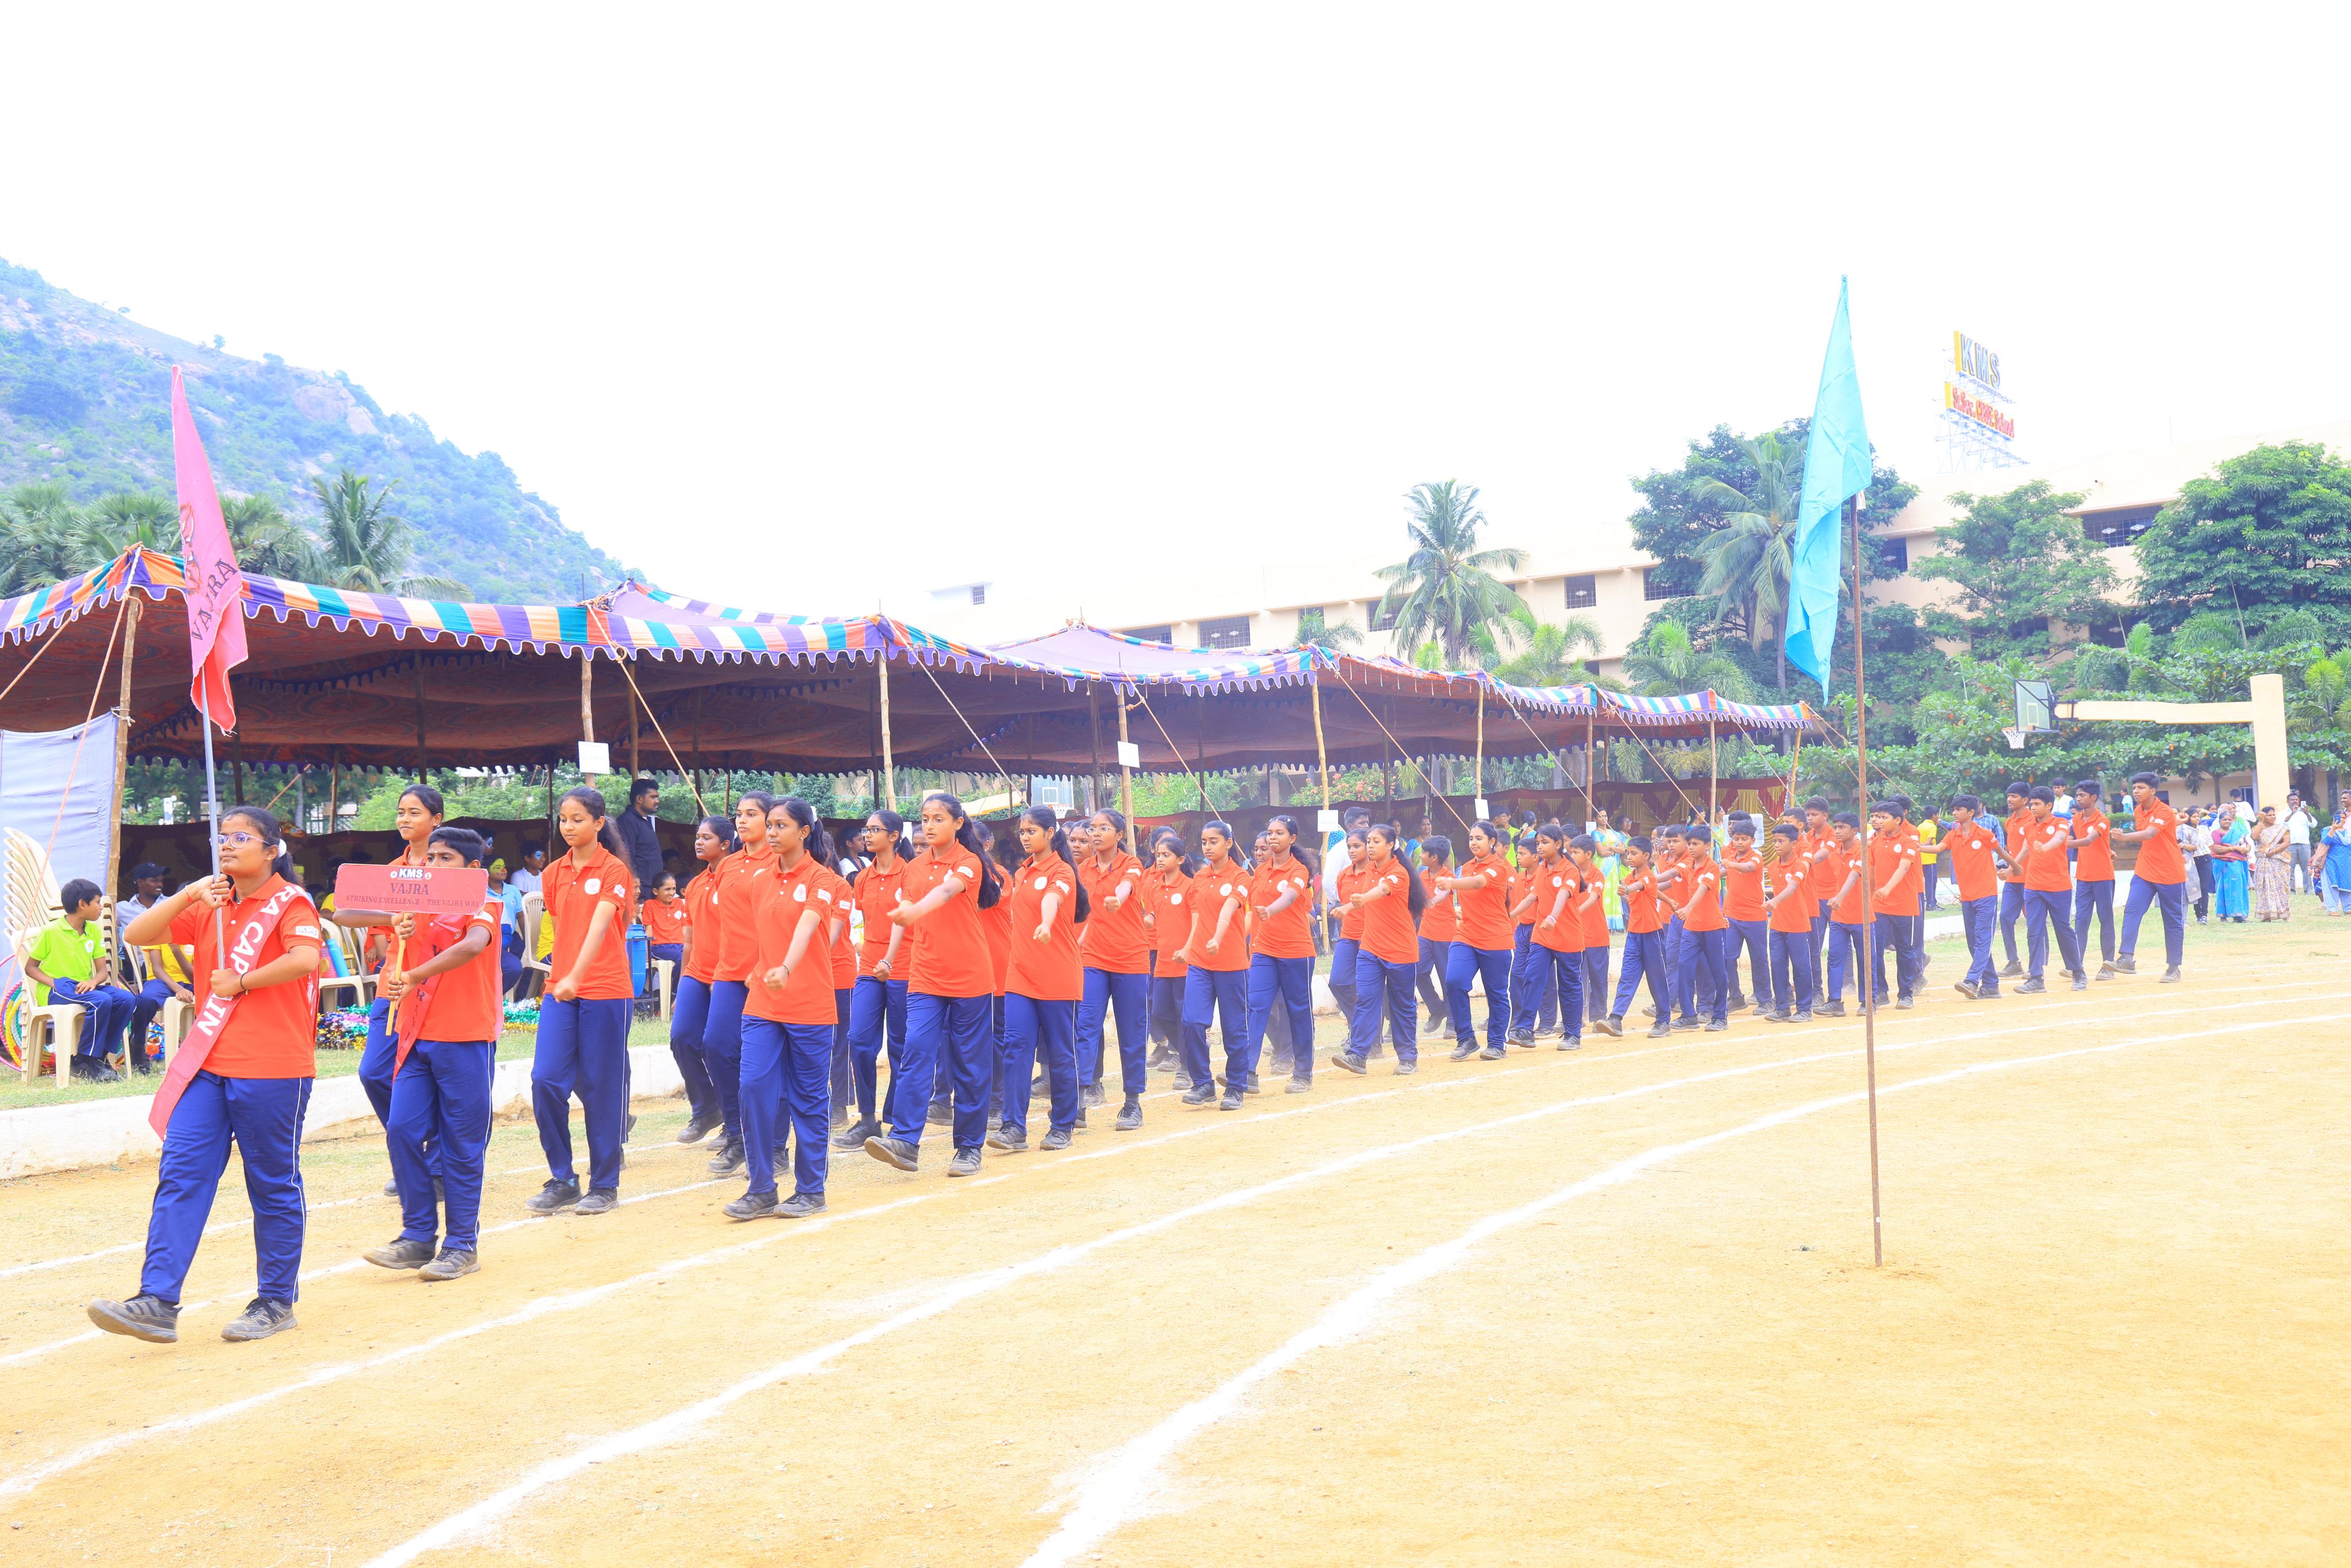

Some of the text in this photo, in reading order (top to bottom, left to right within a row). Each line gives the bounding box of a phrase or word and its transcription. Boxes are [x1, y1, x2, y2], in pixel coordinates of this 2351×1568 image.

[1961, 333, 2000, 390] KMS
[191, 558, 238, 641] VAJRA
[390, 882, 429, 895] VAJRA
[398, 868, 423, 878] KMS
[379, 896, 420, 905] EXCELLENCE
[197, 921, 263, 1037] CAPIN
